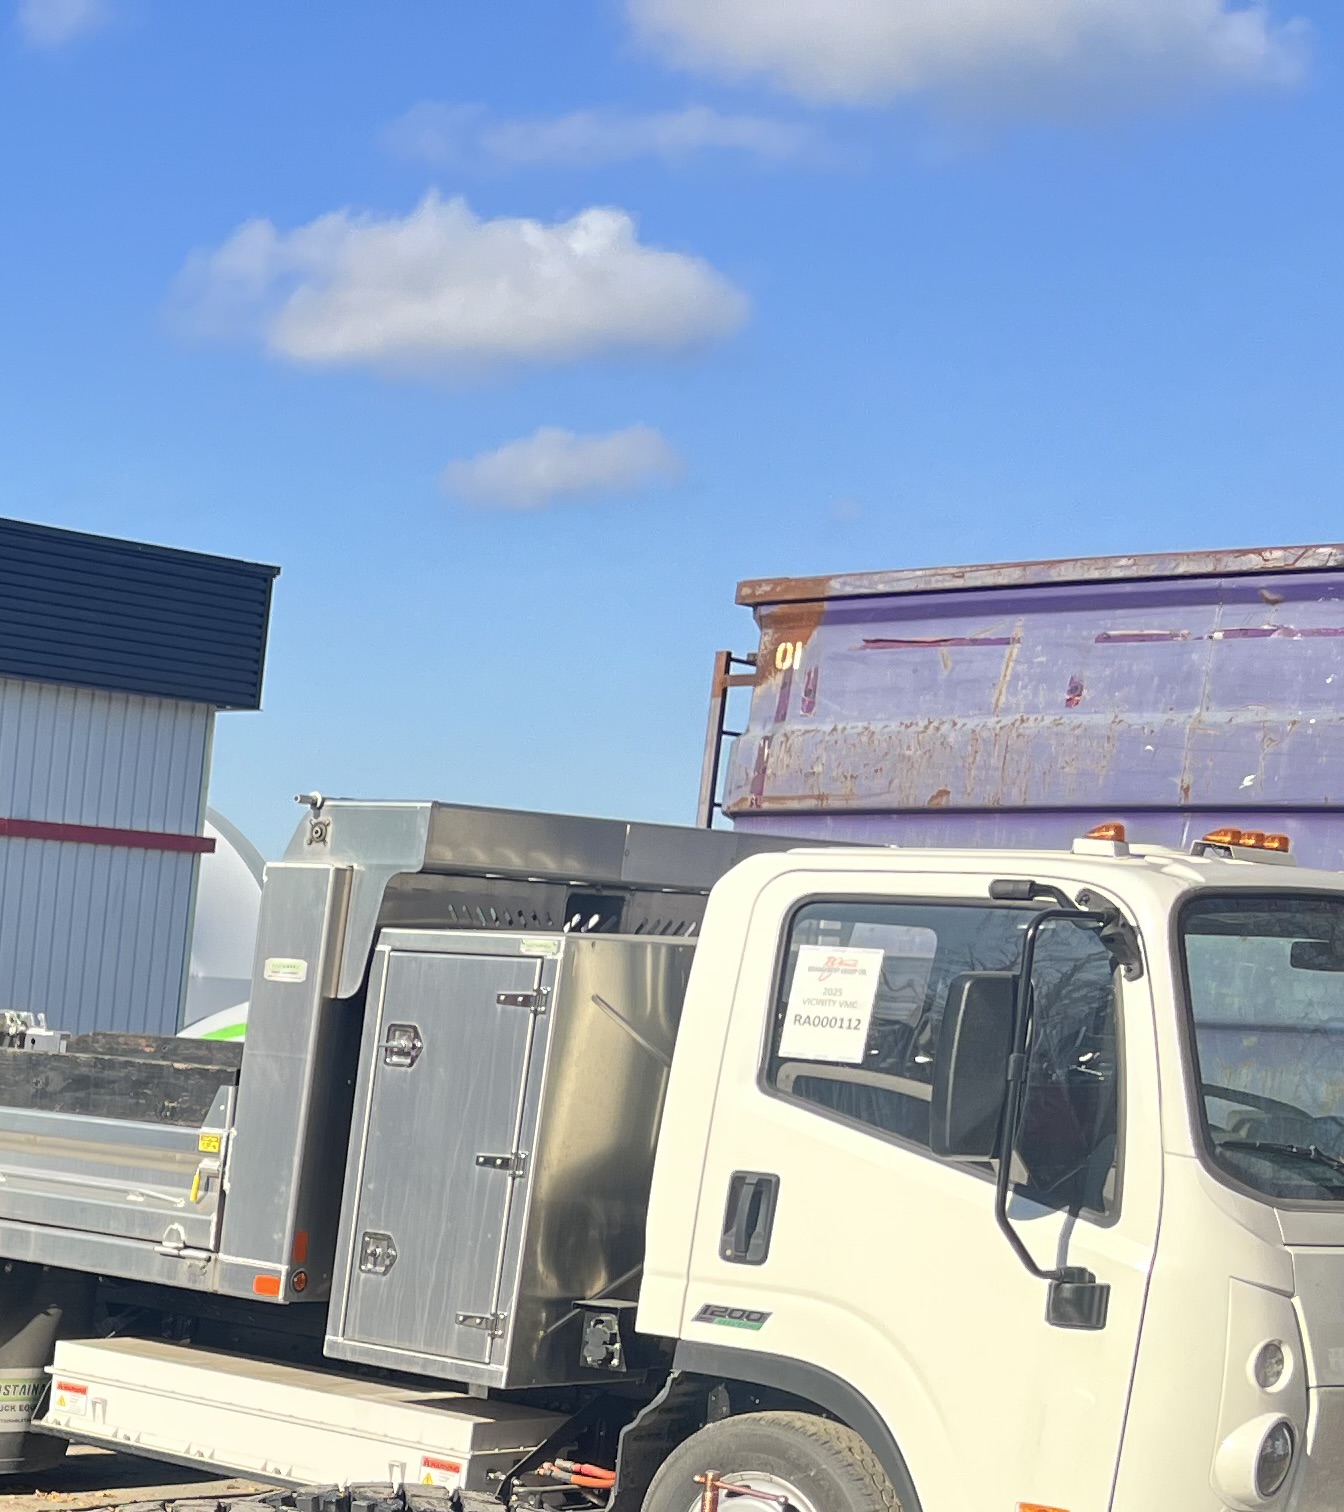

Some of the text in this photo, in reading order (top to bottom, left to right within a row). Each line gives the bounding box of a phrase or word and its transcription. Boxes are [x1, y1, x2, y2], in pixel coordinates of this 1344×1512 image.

[822, 987, 843, 996] 2025
[802, 997, 837, 1008] VICINITY
[793, 1013, 861, 1031] RA000112
[700, 1304, 765, 1322] 1200
